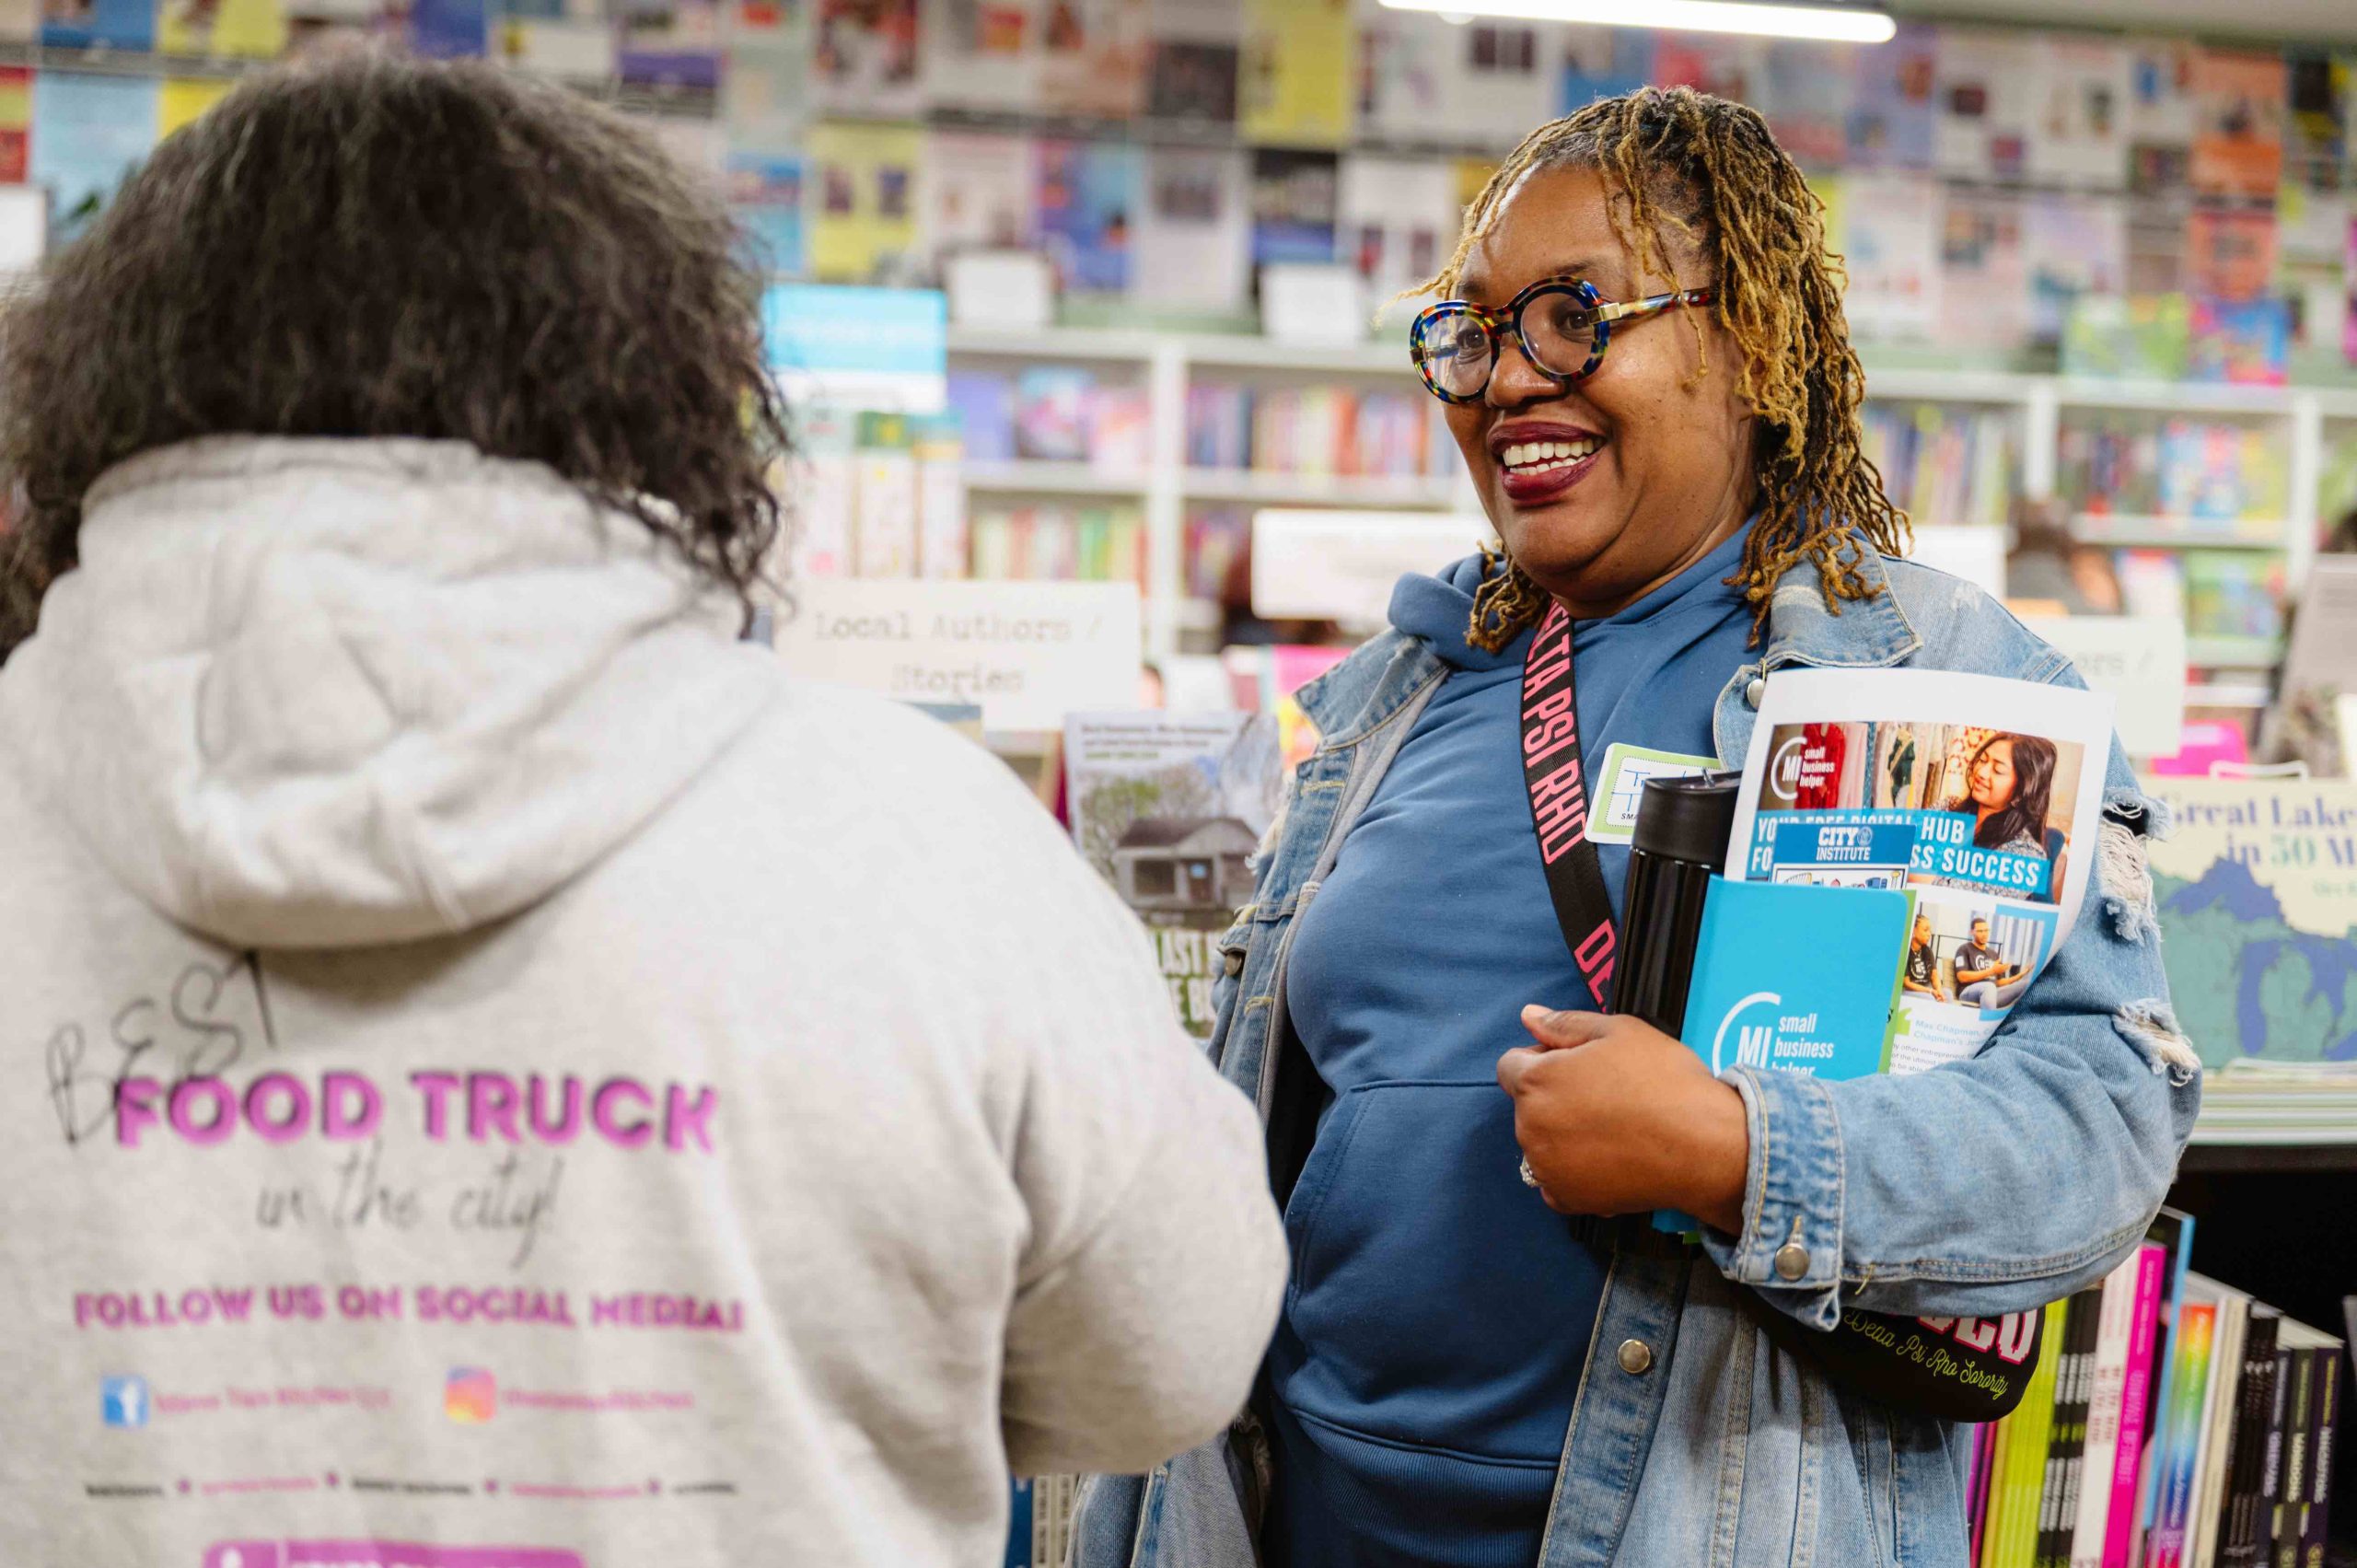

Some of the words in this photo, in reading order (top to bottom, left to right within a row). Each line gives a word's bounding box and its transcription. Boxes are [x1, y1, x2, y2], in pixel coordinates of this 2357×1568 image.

[815, 611, 912, 642] Local
[929, 612, 1072, 643] Authors
[891, 662, 1026, 694] Stories
[1522, 687, 1576, 768] PSI
[1801, 761, 1836, 773] business
[1804, 746, 1827, 761] small
[1799, 774, 1826, 789] helper
[1530, 758, 1585, 865] RHO
[1817, 826, 1860, 846] CITY
[1921, 816, 1966, 844] HUB
[1816, 846, 1872, 861] INSTITUTE
[2226, 830, 2262, 865] in
[2270, 833, 2316, 866] 50
[1941, 847, 2039, 887] SUCCESS
[1778, 1014, 1817, 1034] small
[45, 949, 279, 1148] BEST
[1773, 1037, 1835, 1059] business
[114, 1070, 384, 1149] FOOD
[410, 1071, 719, 1153] TRUCK
[255, 1185, 309, 1229] in
[330, 1138, 424, 1230] the
[73, 1286, 254, 1331] FOLLOW
[268, 1284, 325, 1323] US
[337, 1284, 402, 1323] ON
[416, 1285, 577, 1330] SOCIAL
[590, 1291, 747, 1332] MEDIA!
[1896, 1334, 1930, 1365] Psi
[1926, 1347, 1958, 1377] Rho
[1959, 1358, 2009, 1400] Sorority
